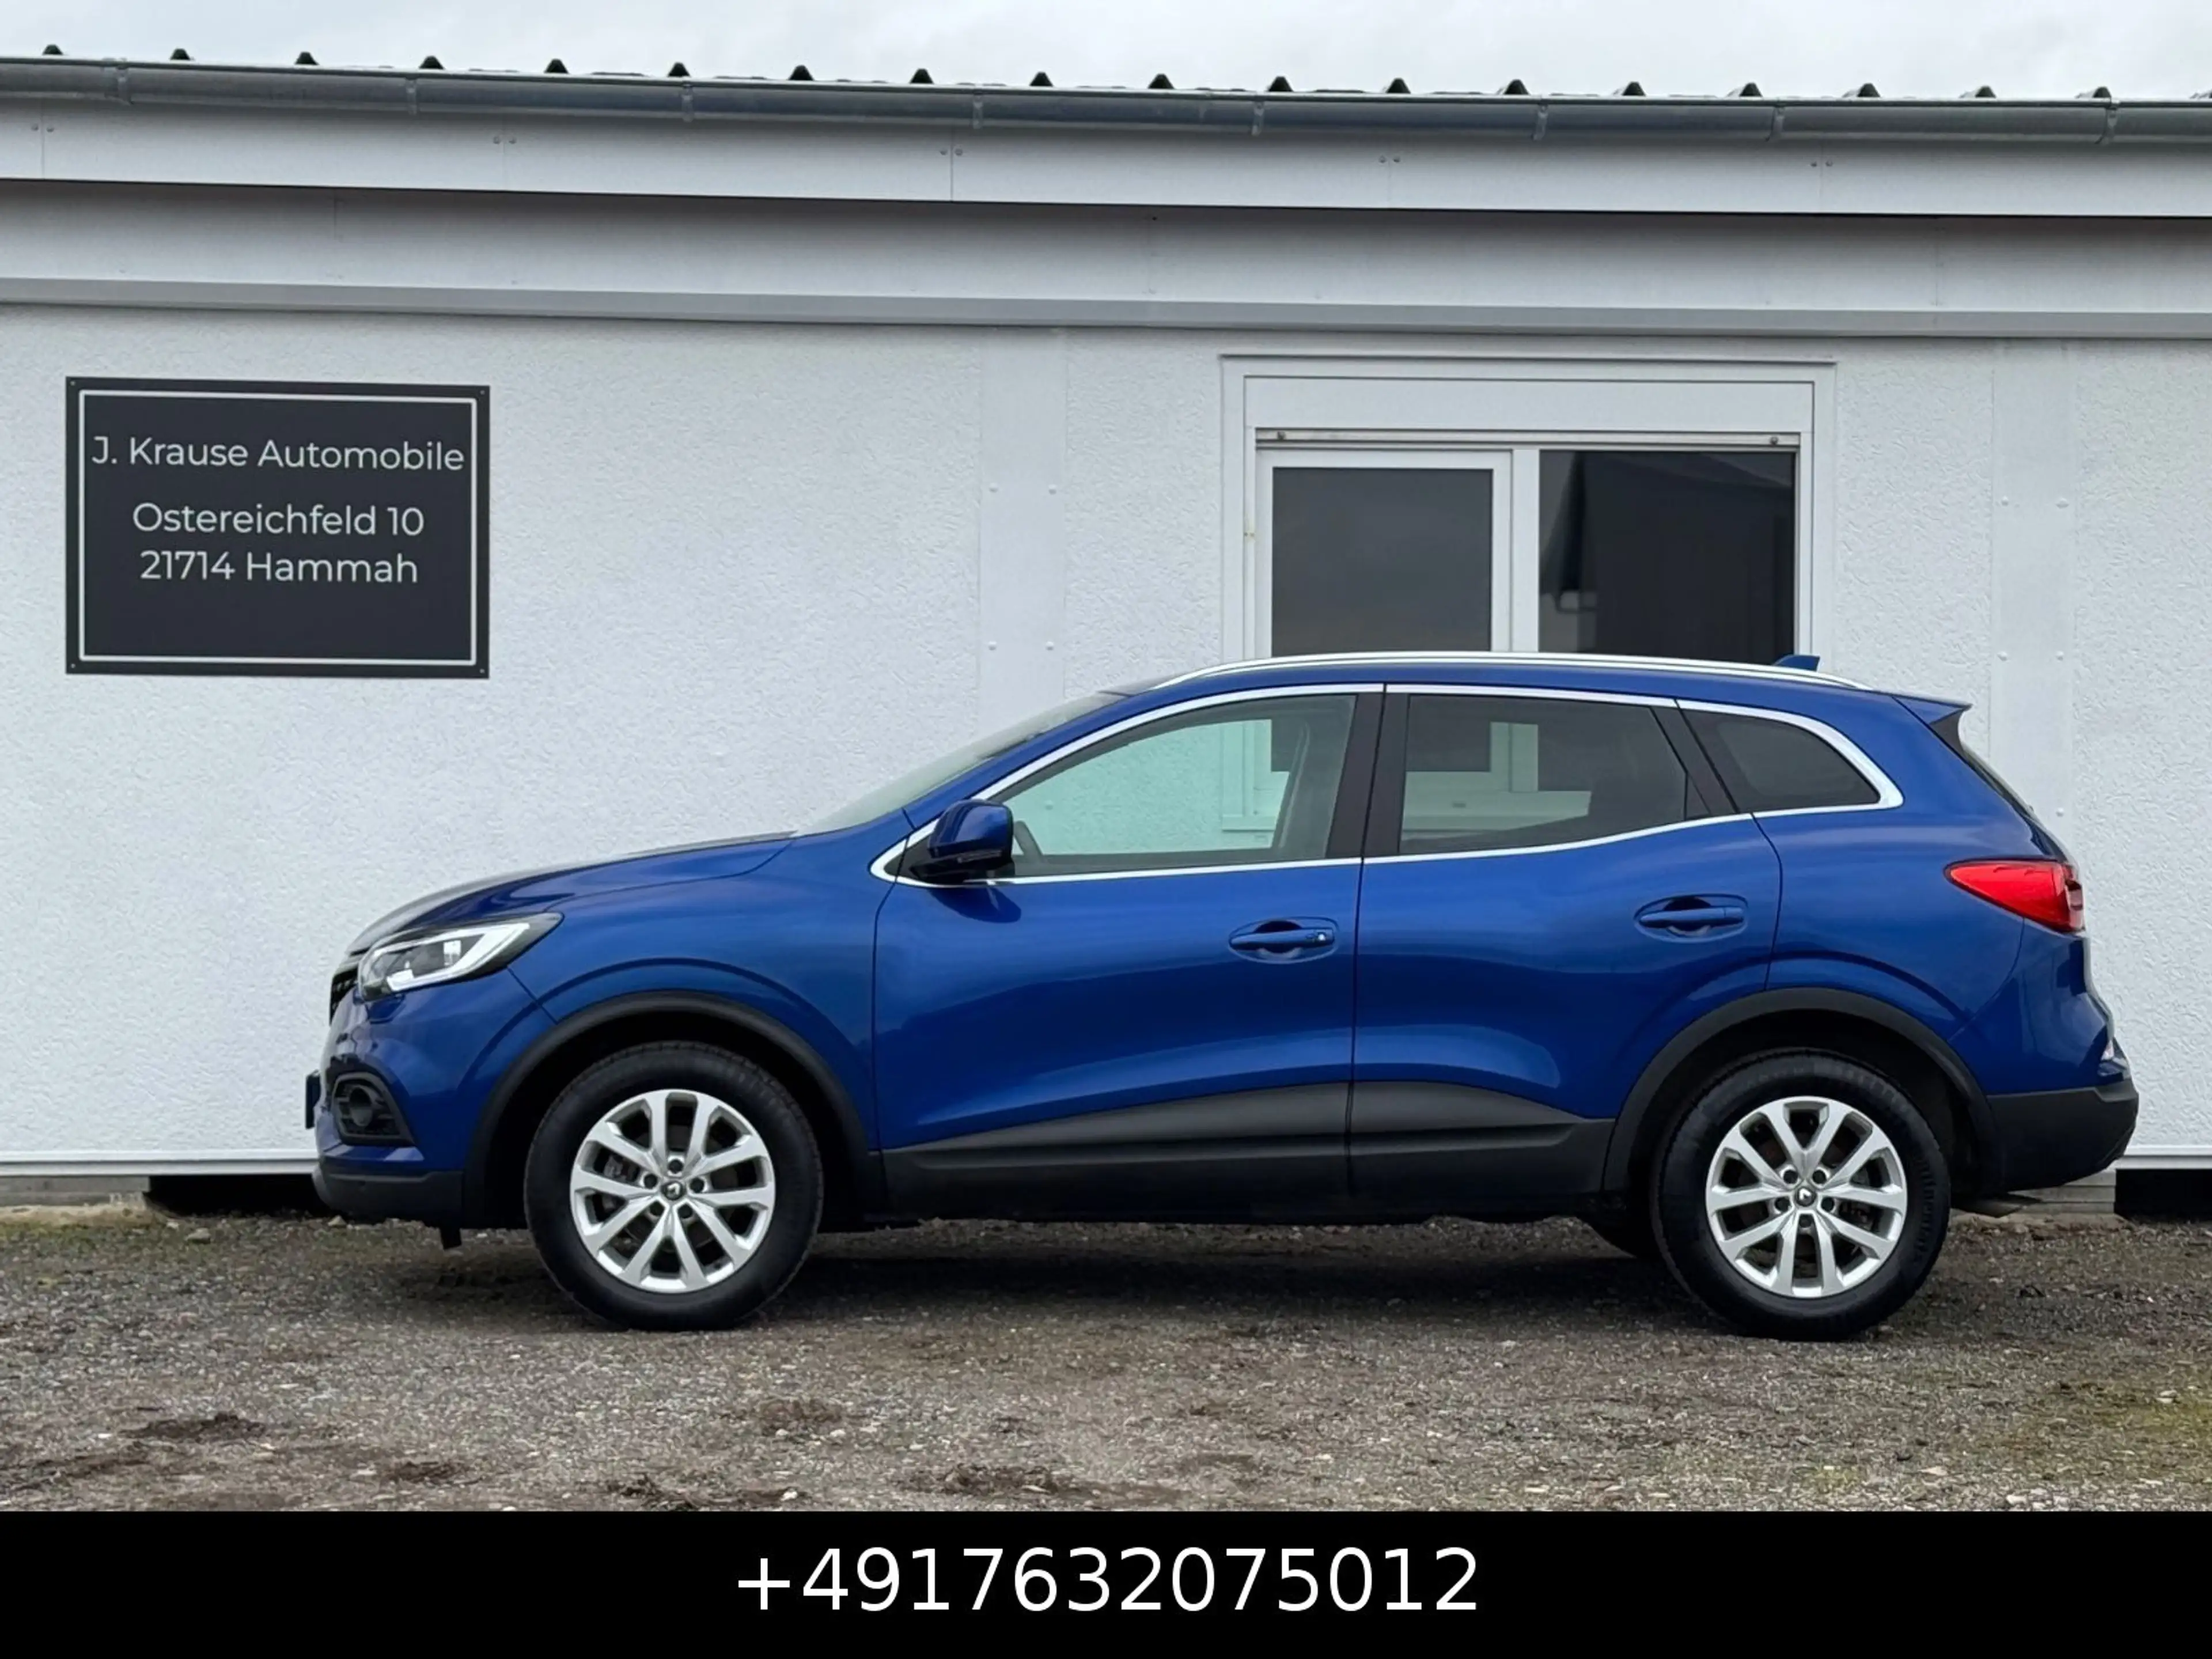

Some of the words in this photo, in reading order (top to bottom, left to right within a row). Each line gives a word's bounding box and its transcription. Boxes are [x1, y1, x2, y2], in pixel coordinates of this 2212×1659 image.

[92, 435, 118, 464] J.
[130, 437, 249, 467] Krause
[257, 440, 465, 471] Automobile
[132, 502, 376, 536] Ostereichfeld
[387, 507, 425, 536] 10
[140, 550, 236, 581] 21714
[247, 551, 418, 584] Hammah
